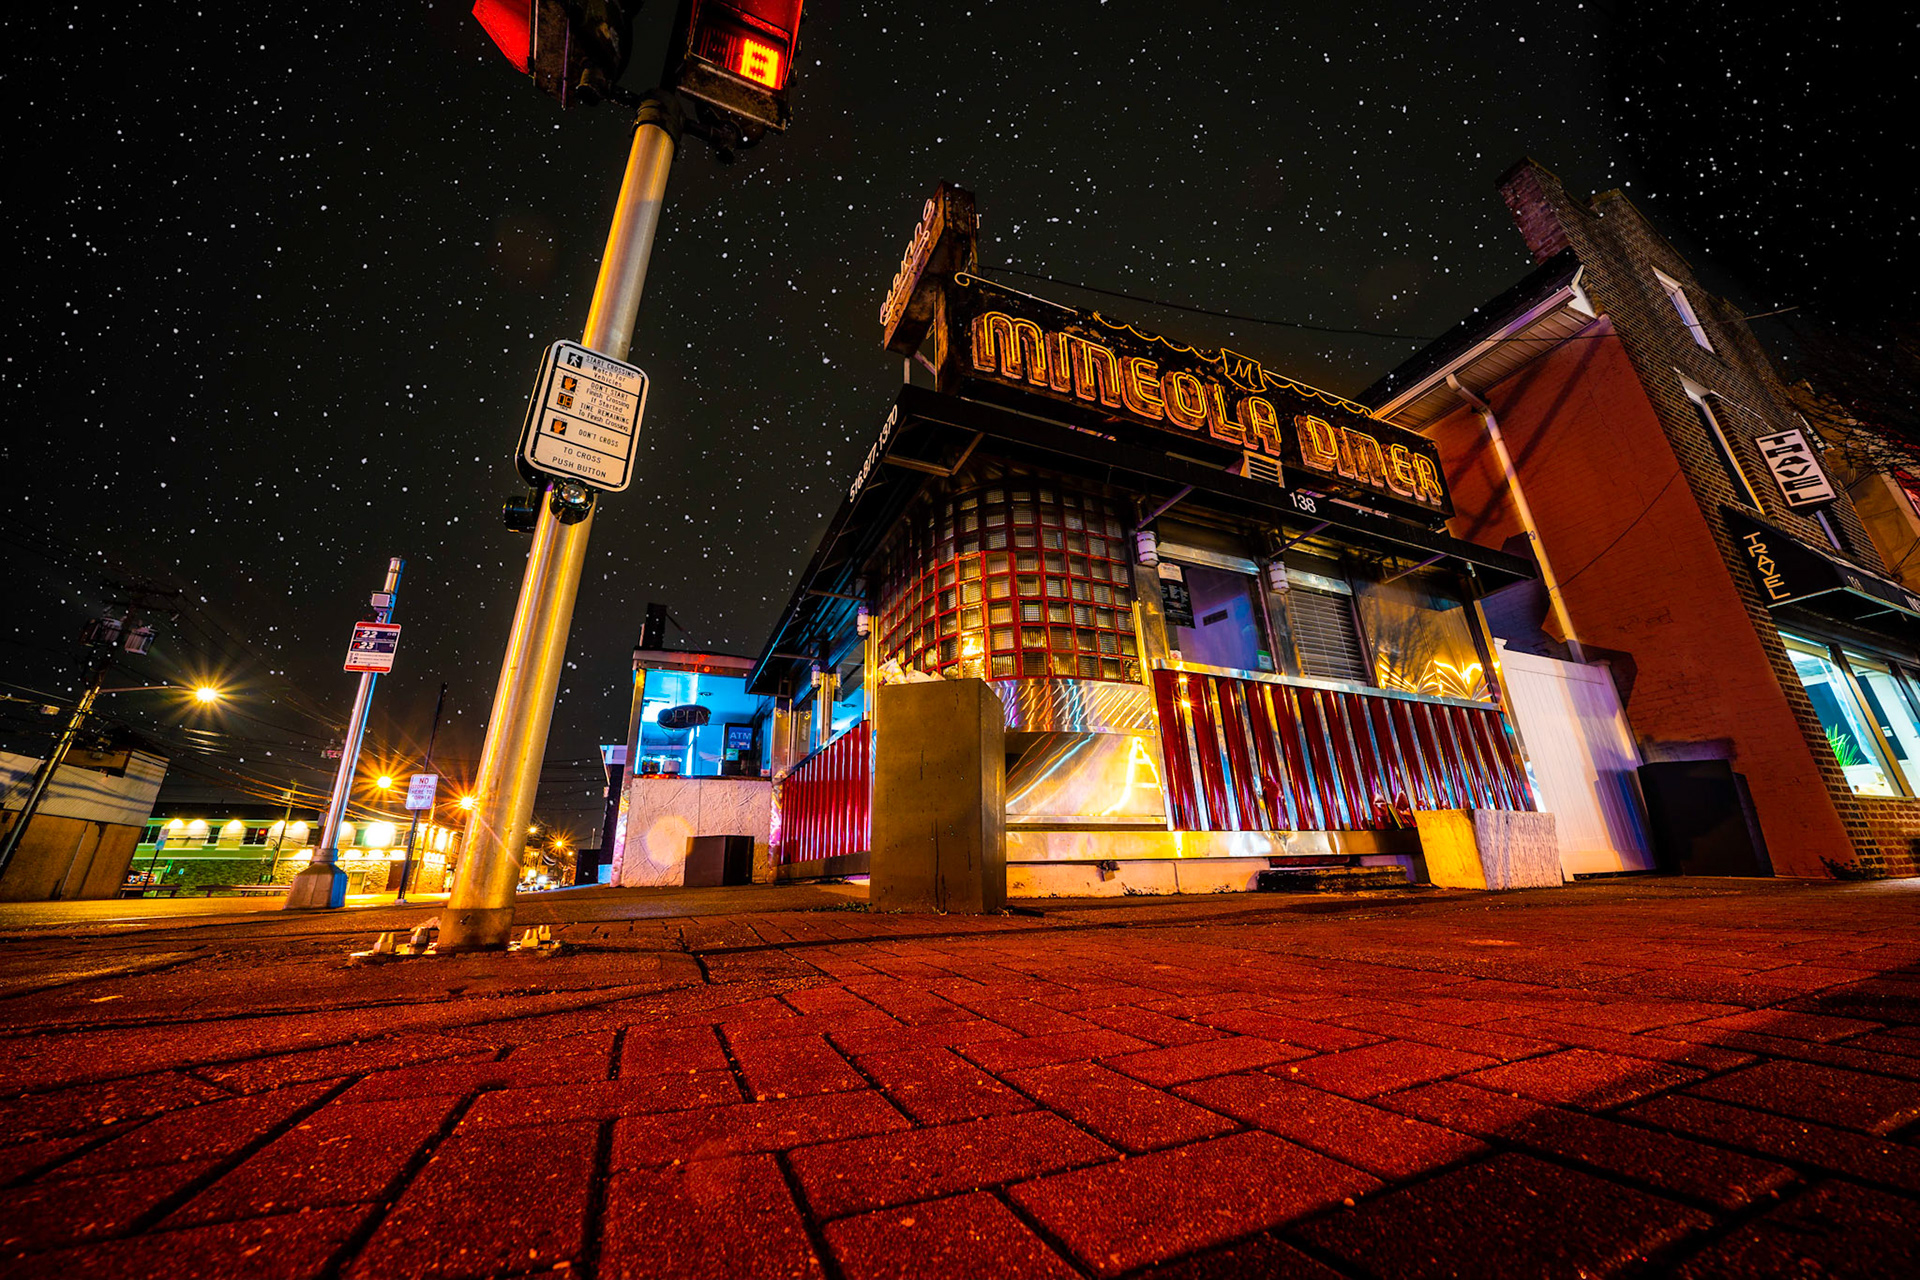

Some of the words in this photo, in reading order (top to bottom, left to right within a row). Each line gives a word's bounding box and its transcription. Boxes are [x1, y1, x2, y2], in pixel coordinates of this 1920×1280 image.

[586, 355, 605, 366] START
[607, 363, 635, 379] CROSSING
[592, 365, 613, 378] Watch
[594, 372, 622, 388] Vehicles
[590, 382, 608, 393] DON'T
[610, 389, 629, 400] START
[580, 402, 594, 413] TIME
[598, 408, 630, 425] REMAINING
[972, 311, 1282, 457] MINEOLA
[1294, 415, 1443, 506] DINER
[578, 429, 597, 440] DON'T
[599, 436, 619, 448] CROSS
[563, 446, 573, 455] TO
[576, 450, 602, 464] CROSS
[551, 456, 575, 469] PUSH
[576, 463, 607, 478] BUTTON
[1289, 492, 1317, 514] 138
[1743, 531, 1791, 601] TRAVEL
[729, 731, 752, 740] ATM
[419, 777, 430, 785] NO
